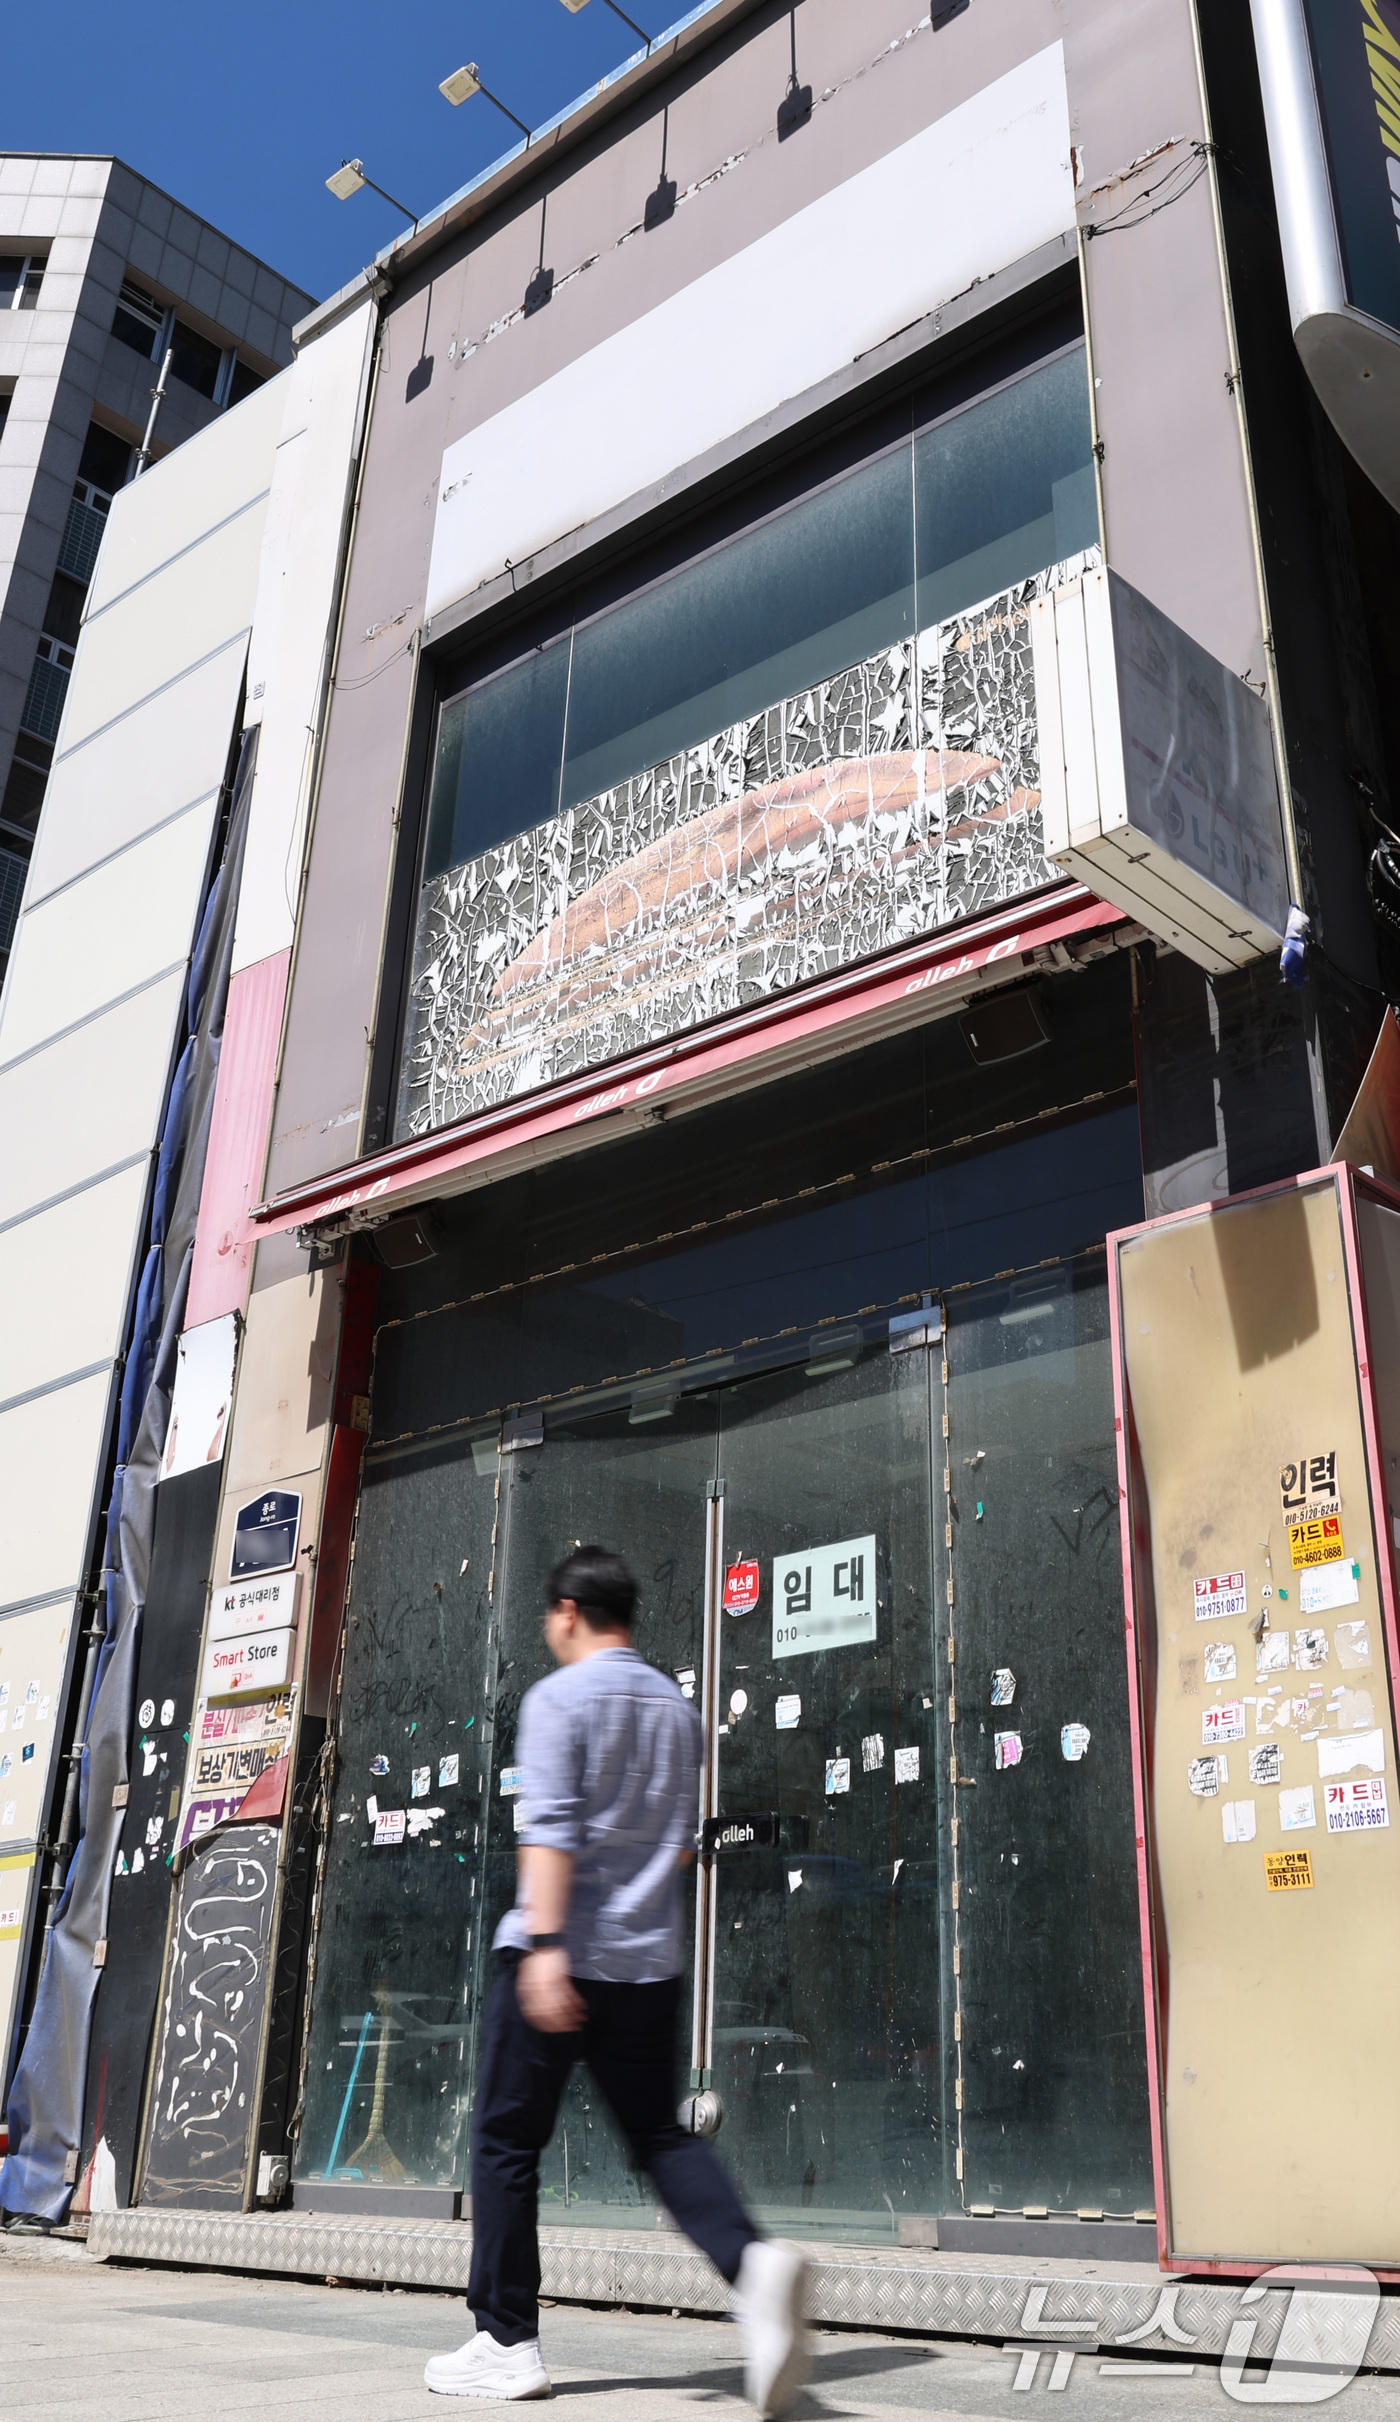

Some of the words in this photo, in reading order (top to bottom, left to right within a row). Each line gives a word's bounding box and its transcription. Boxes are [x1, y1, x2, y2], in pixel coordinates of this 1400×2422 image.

[1280, 1451, 1336, 1509] 인력
[261, 1500, 277, 1516] 종로
[1284, 1502, 1339, 1526] 010-5120-6244
[1291, 1523, 1322, 1544] 카드
[1292, 1545, 1342, 1566] 010-4602-0888
[728, 1574, 754, 1593] 에스원
[1196, 1576, 1231, 1597] 카드
[224, 1596, 235, 1612] kt
[238, 1586, 280, 1609] 공식대리점
[213, 1648, 244, 1669] Smart
[247, 1643, 278, 1662] Store
[1205, 1710, 1234, 1728] 카드
[1328, 1783, 1369, 1803] 카드
[378, 1813, 399, 1828] 카드
[1329, 1807, 1385, 1830] 010-2106-5667
[1272, 1873, 1311, 1887] 975-3111
